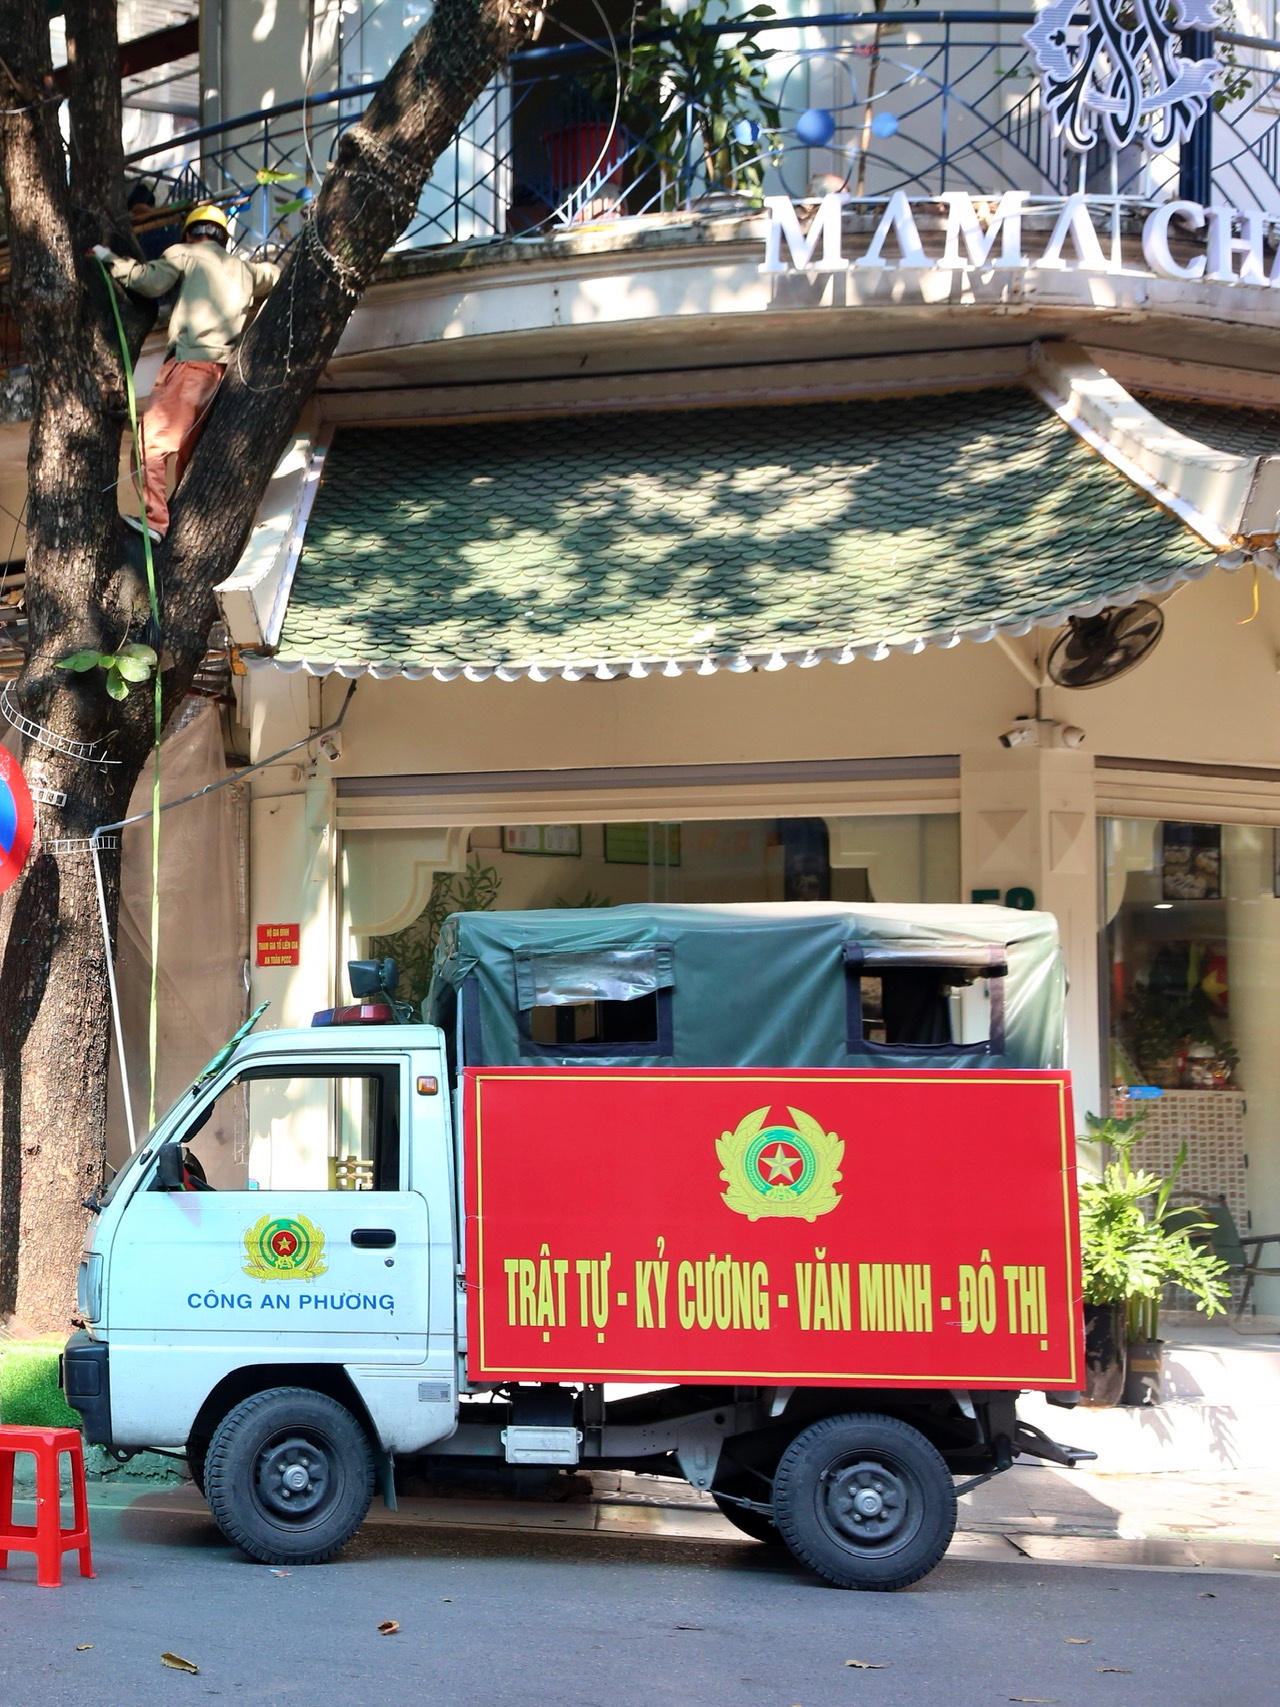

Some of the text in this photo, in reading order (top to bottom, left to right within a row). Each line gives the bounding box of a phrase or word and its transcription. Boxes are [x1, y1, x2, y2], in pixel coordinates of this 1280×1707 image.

[758, 190, 1280, 290] MAMA CH
[187, 1289, 252, 1309] CÔNG
[260, 1294, 290, 1309] AN
[504, 1235, 1048, 1351] TRẬT TỰ - KỶ CƯƠNG - VĂN MINH - ĐÔ THỊ
